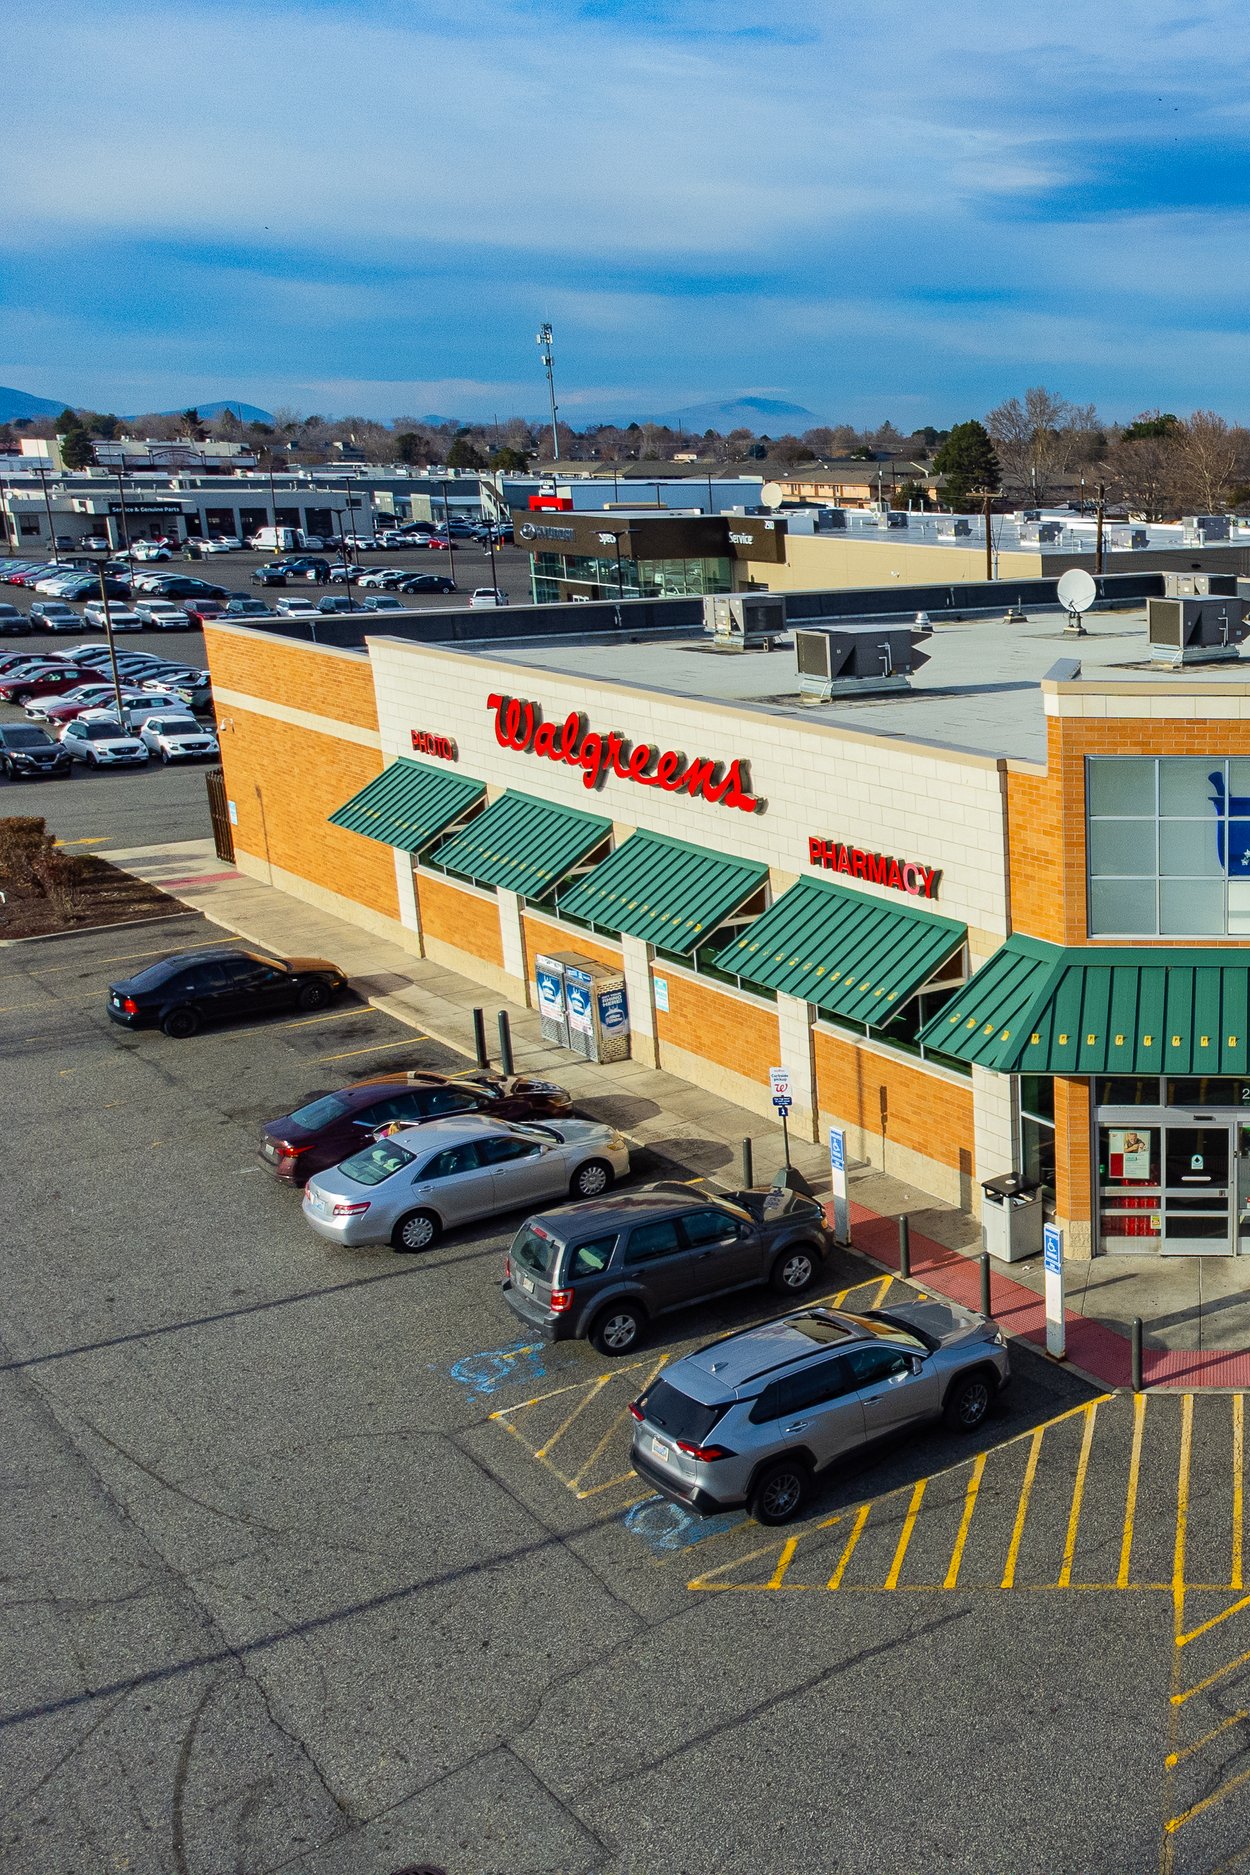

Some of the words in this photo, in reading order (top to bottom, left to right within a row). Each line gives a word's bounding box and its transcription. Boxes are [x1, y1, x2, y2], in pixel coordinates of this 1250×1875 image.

[728, 531, 754, 545] Service
[410, 729, 457, 763] PHOTO
[486, 692, 763, 815] Walgreens
[808, 835, 942, 901] PHARMACY
